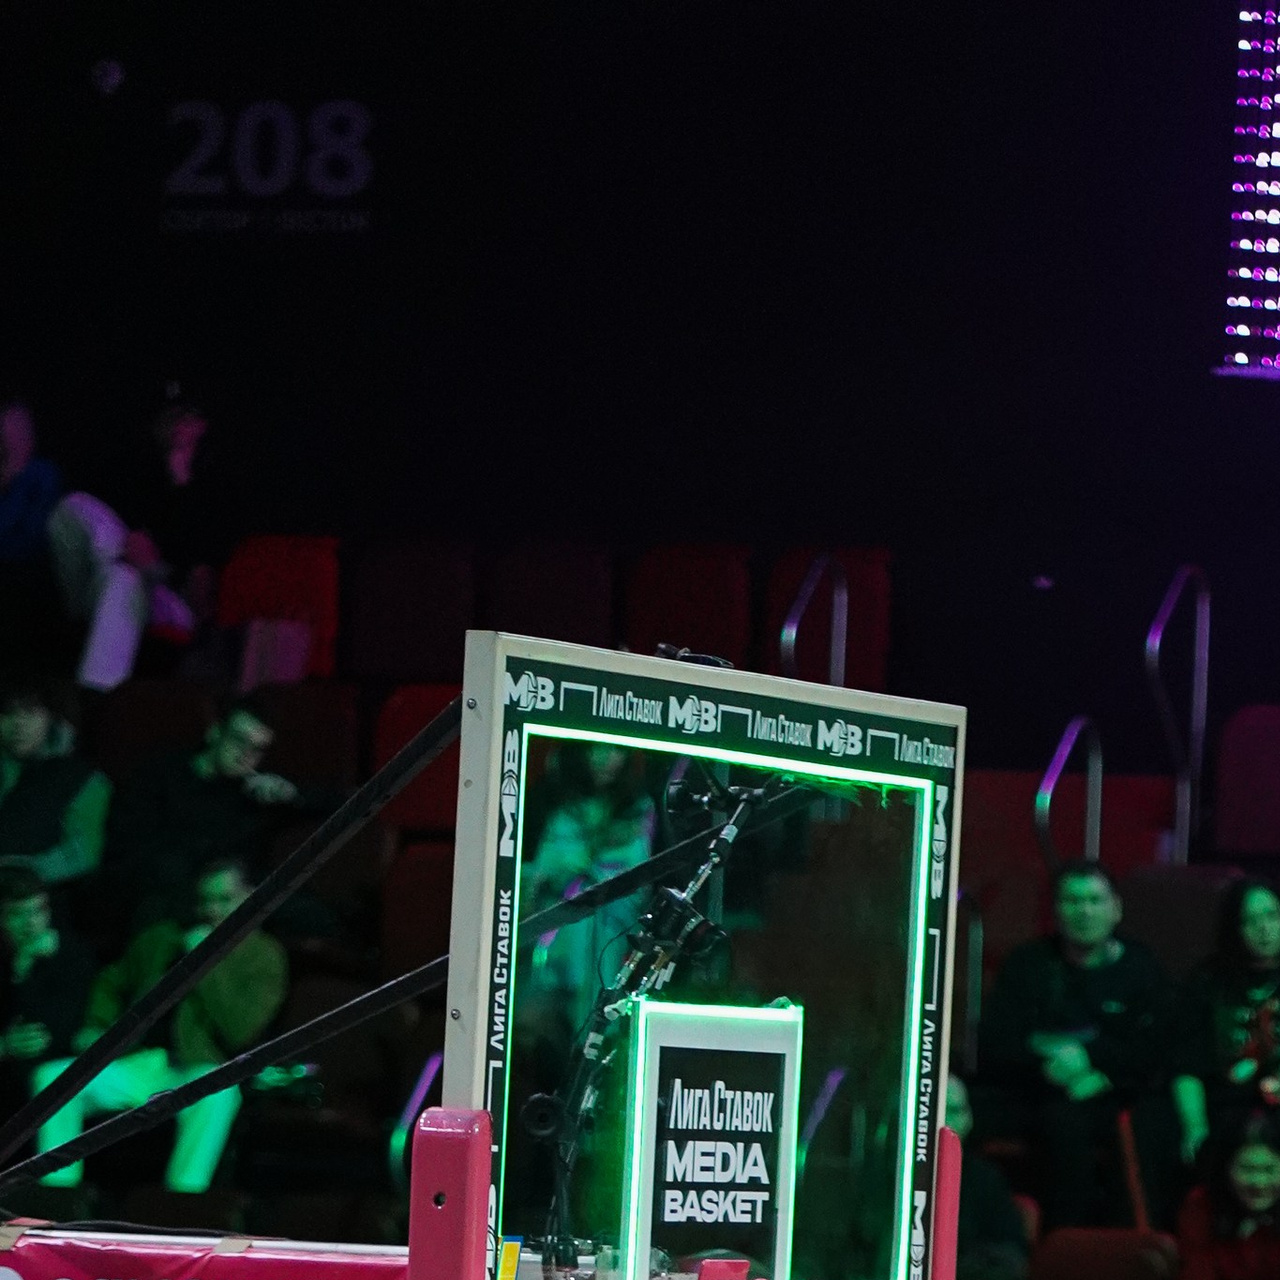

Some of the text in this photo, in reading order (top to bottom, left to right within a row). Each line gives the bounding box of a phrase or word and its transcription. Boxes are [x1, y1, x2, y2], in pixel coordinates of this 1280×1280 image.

[166, 99, 372, 197] 208
[665, 1140, 771, 1185] MEDIA
[663, 1189, 770, 1223] BASKET
